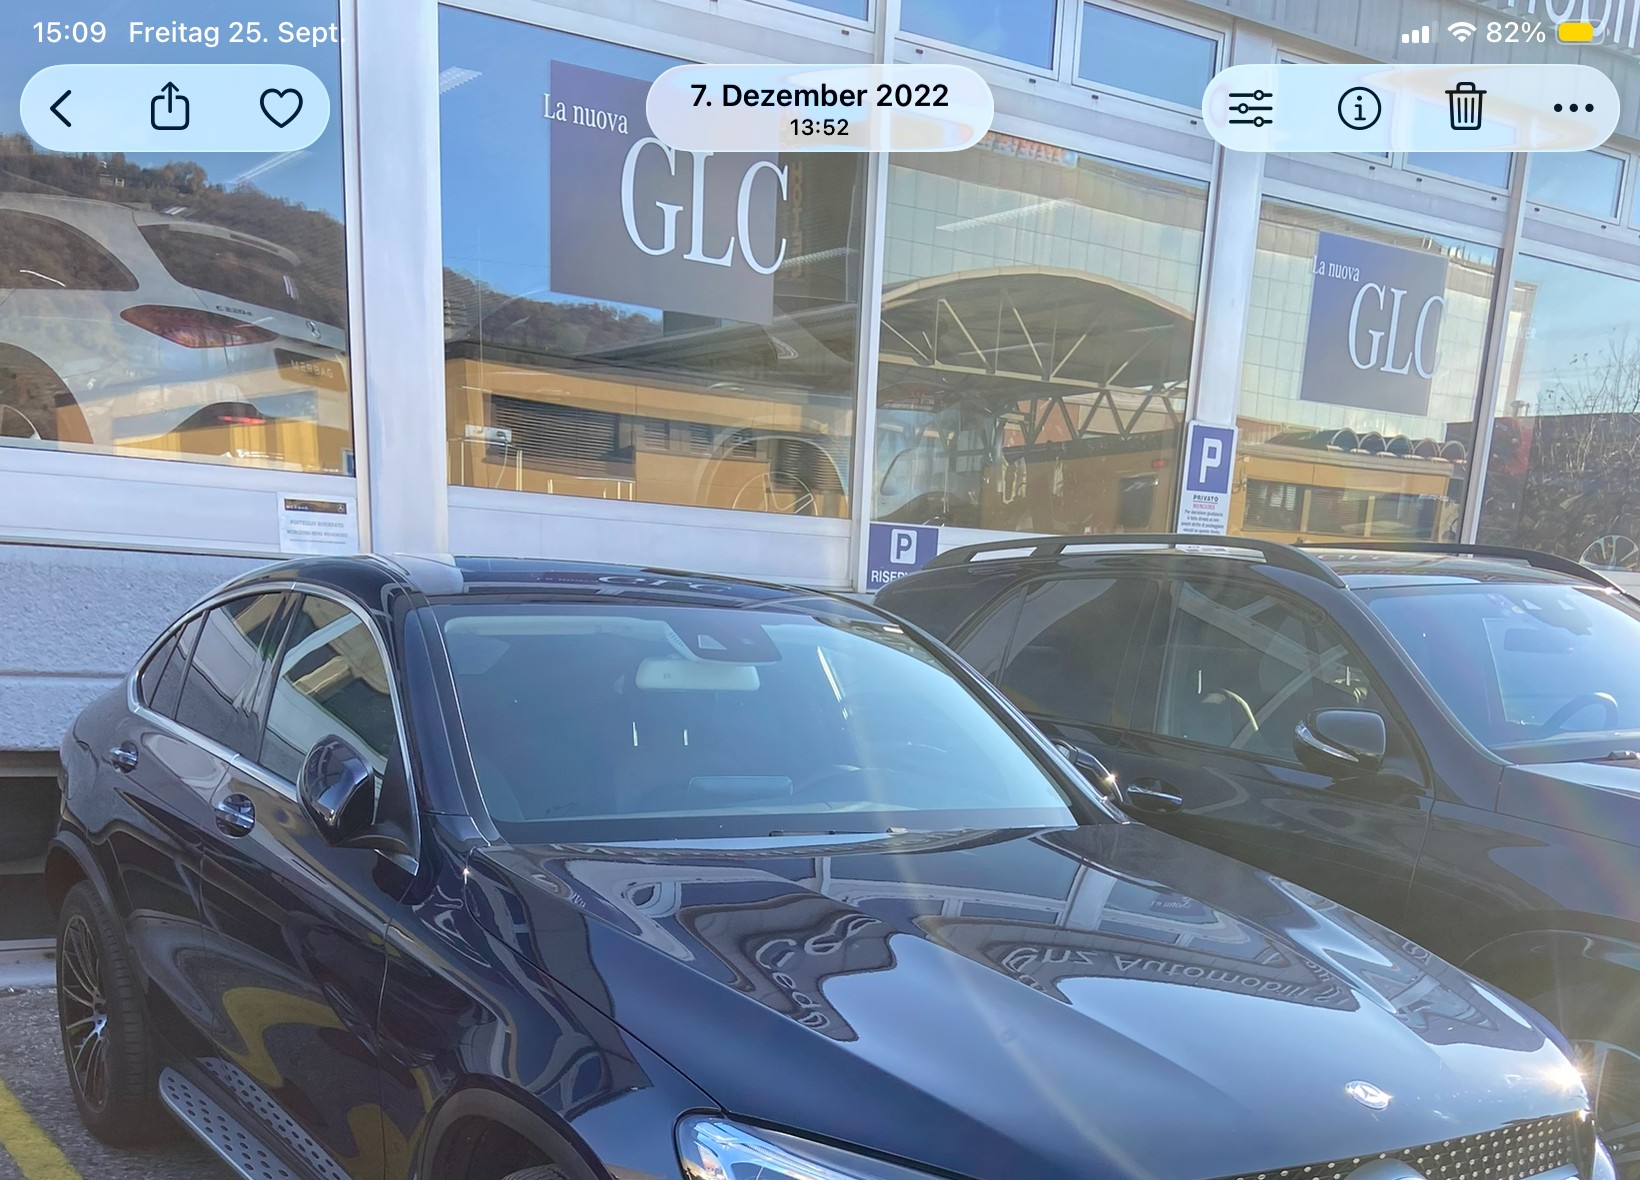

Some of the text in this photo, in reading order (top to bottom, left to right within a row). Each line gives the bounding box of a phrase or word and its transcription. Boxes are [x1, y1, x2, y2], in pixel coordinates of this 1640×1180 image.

[543, 93, 629, 135] La nuova
[621, 136, 789, 275] GLC
[1312, 255, 1360, 282] La nuova
[1348, 282, 1448, 380] GLC
[290, 359, 334, 379] MERBAG
[1199, 437, 1223, 484] P
[1193, 494, 1219, 502] PRIVATO
[896, 533, 912, 559] P
